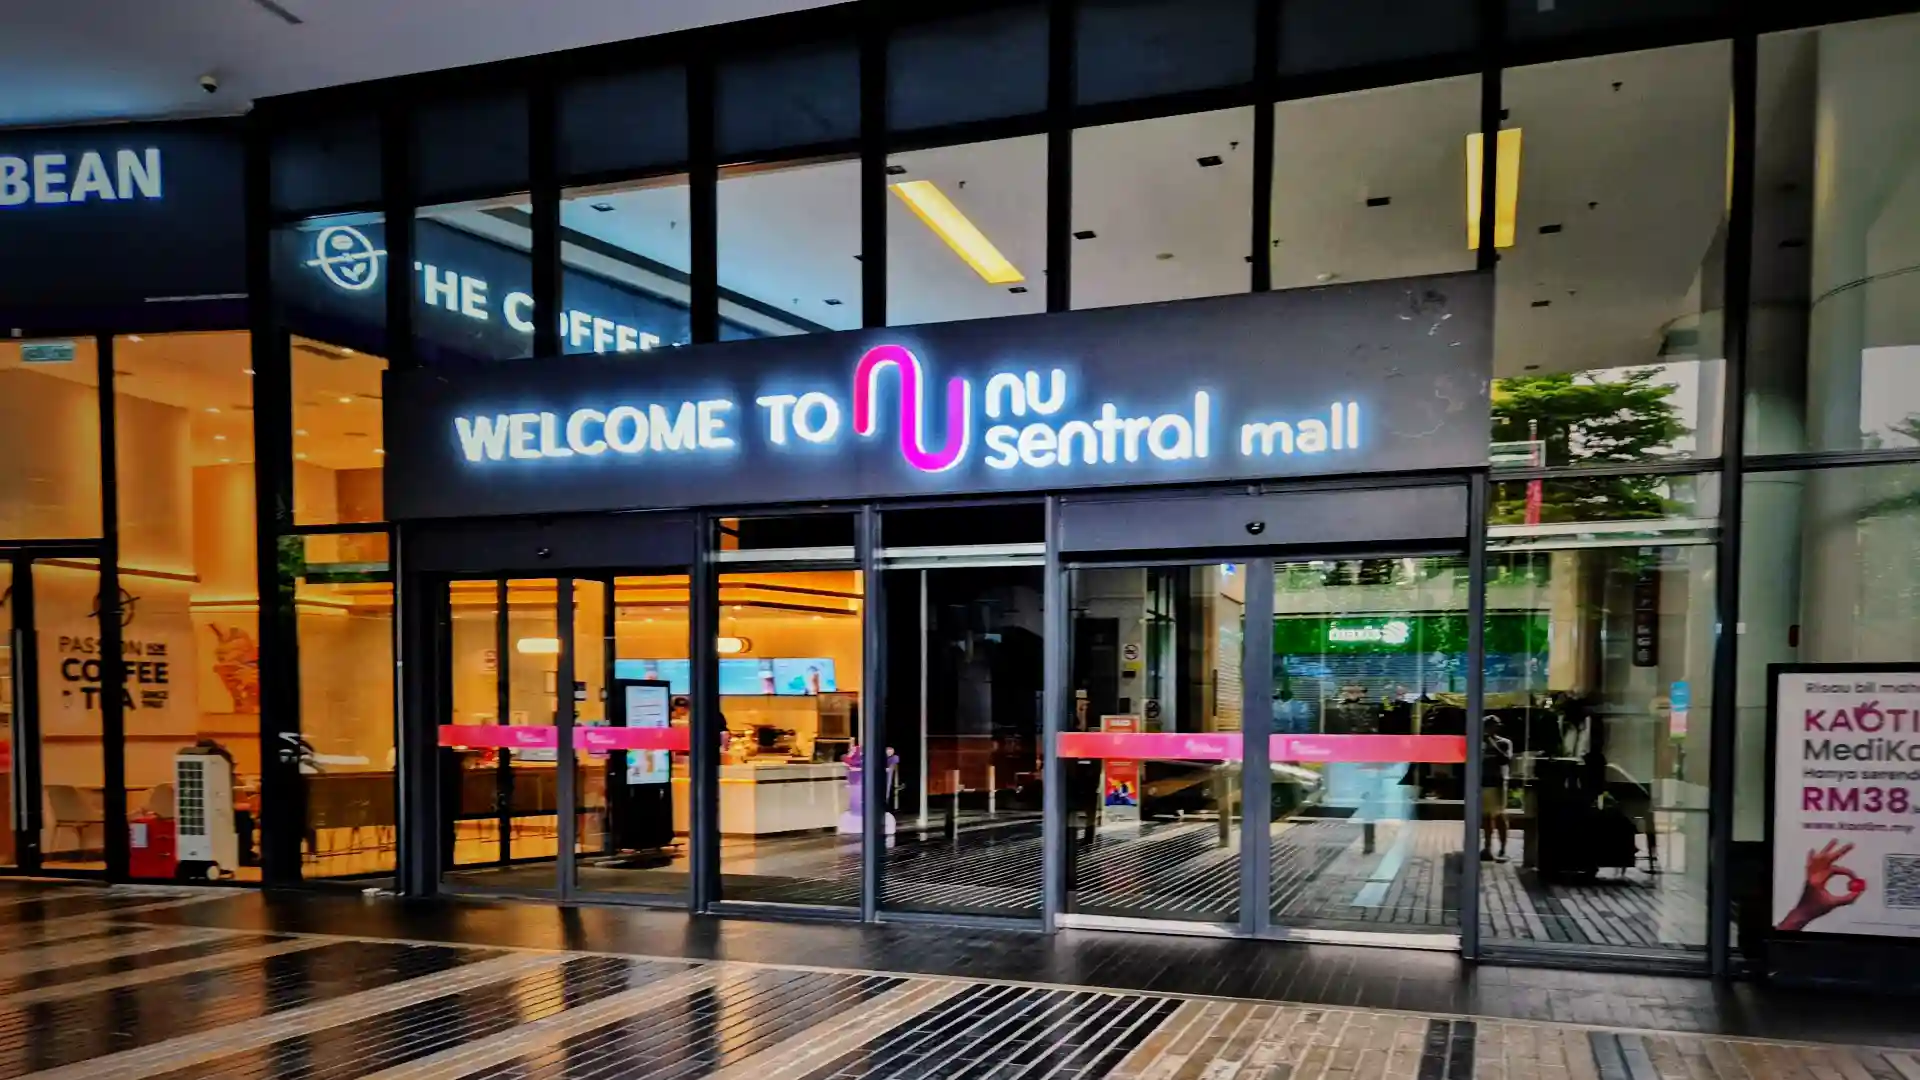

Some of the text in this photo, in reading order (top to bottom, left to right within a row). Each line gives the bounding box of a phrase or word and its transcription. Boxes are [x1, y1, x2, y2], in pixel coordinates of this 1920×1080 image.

[0, 148, 162, 206] BEAN
[414, 261, 489, 321] HE
[984, 368, 1066, 418] nu
[454, 391, 840, 462] WELCOME TO
[984, 391, 1359, 470] sentral mall
[59, 636, 142, 656] PASN
[62, 658, 169, 684] COFEE
[80, 687, 136, 711] TA
